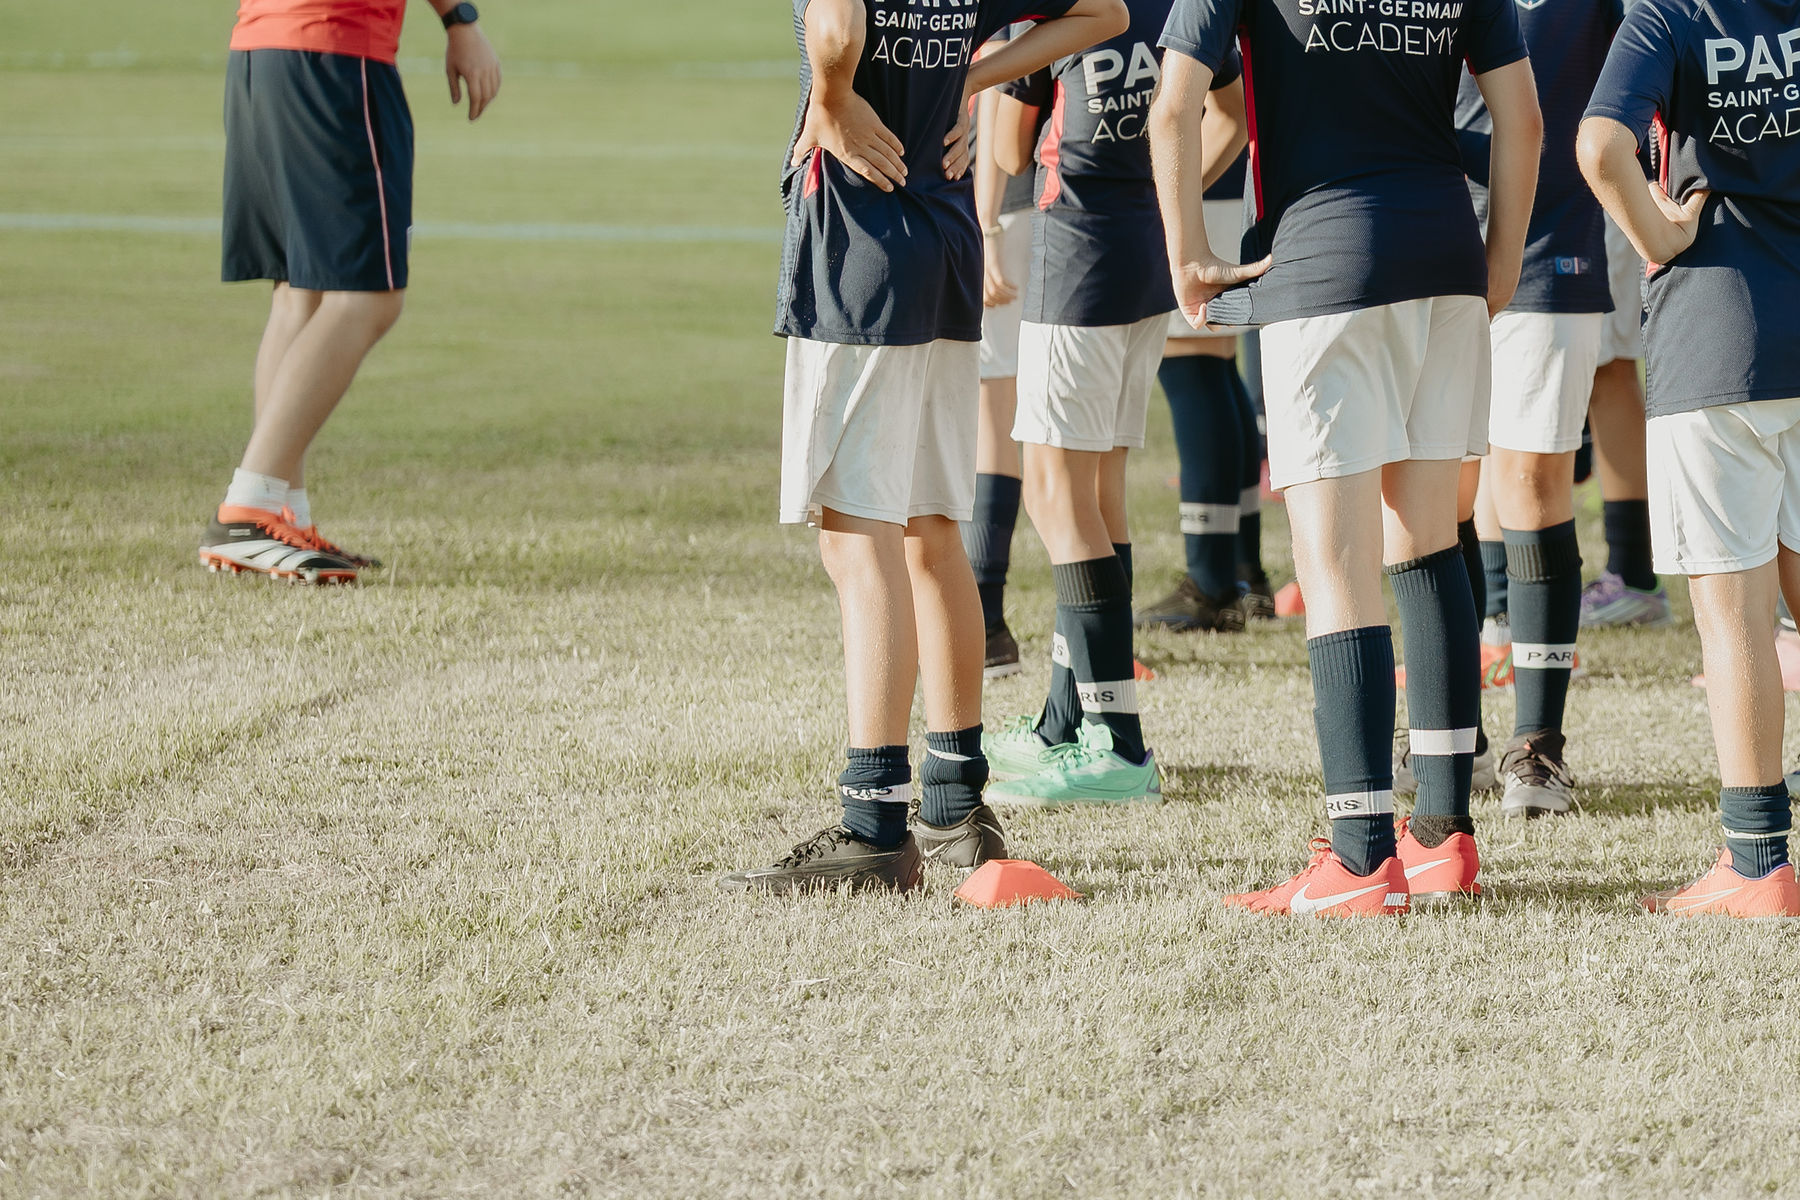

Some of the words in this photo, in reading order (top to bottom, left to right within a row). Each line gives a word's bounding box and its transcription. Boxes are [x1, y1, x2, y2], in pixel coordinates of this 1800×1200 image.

[1305, 21, 1458, 55] ACADEMY
[871, 35, 973, 68] ACADEM
[1527, 651, 1572, 662] PAR
[1080, 690, 1115, 703] RIS
[1383, 892, 1408, 906] NIKE
